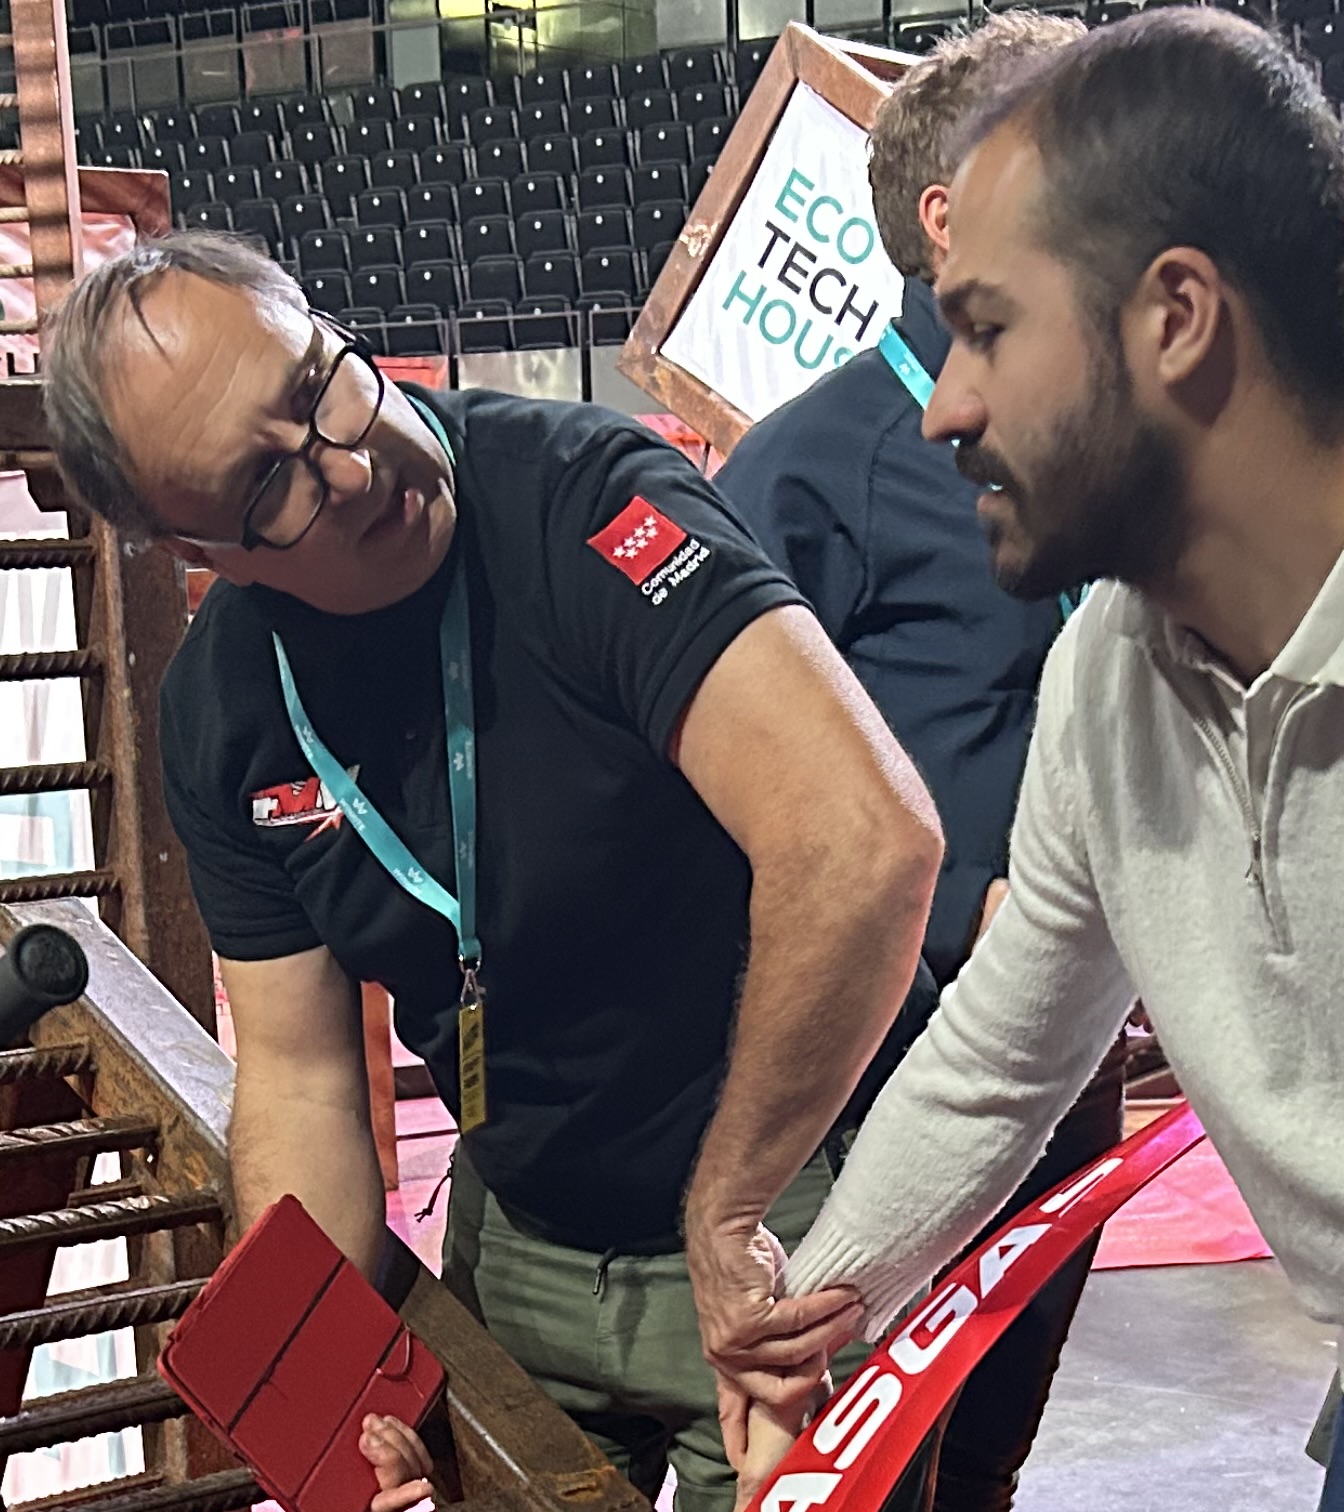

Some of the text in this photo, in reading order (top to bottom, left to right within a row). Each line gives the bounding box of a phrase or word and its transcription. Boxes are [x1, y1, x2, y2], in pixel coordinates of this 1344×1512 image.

[774, 167, 875, 265] ECO
[757, 219, 880, 343] TECH
[641, 538, 700, 596] Comunidad
[651, 546, 711, 606] de Madrid
